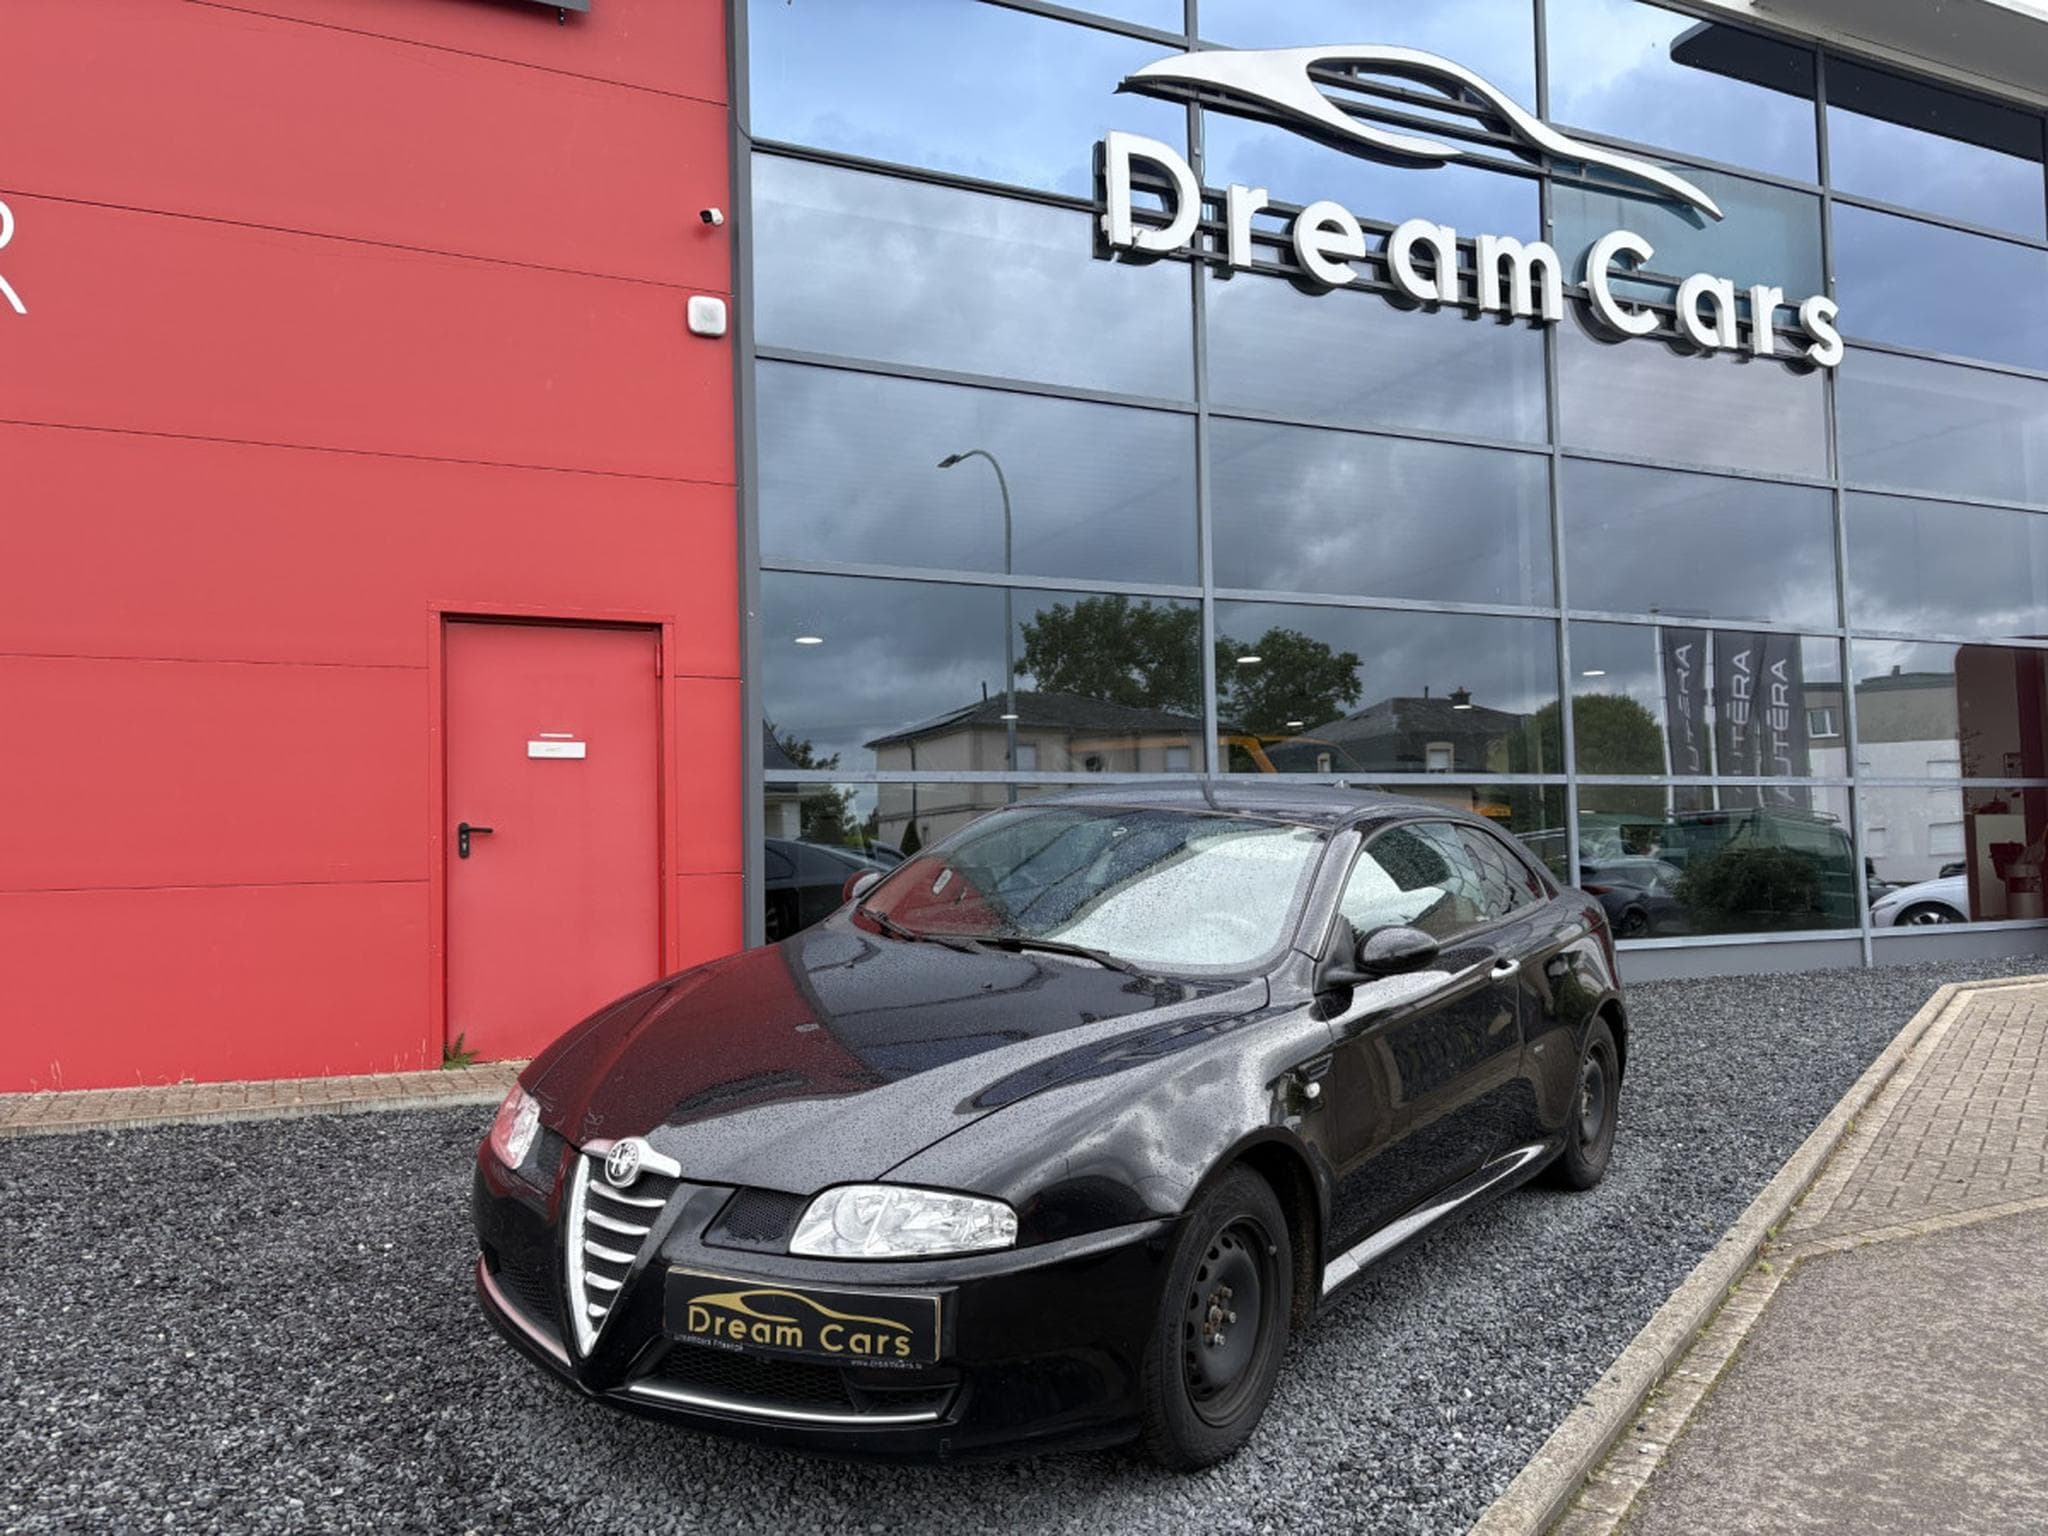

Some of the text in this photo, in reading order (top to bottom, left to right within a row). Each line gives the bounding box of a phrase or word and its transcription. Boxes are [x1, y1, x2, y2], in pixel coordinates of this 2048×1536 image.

[1098, 129, 1845, 368] Dream Cars
[687, 1304, 803, 1348] Dream
[819, 1323, 912, 1356] Cars
